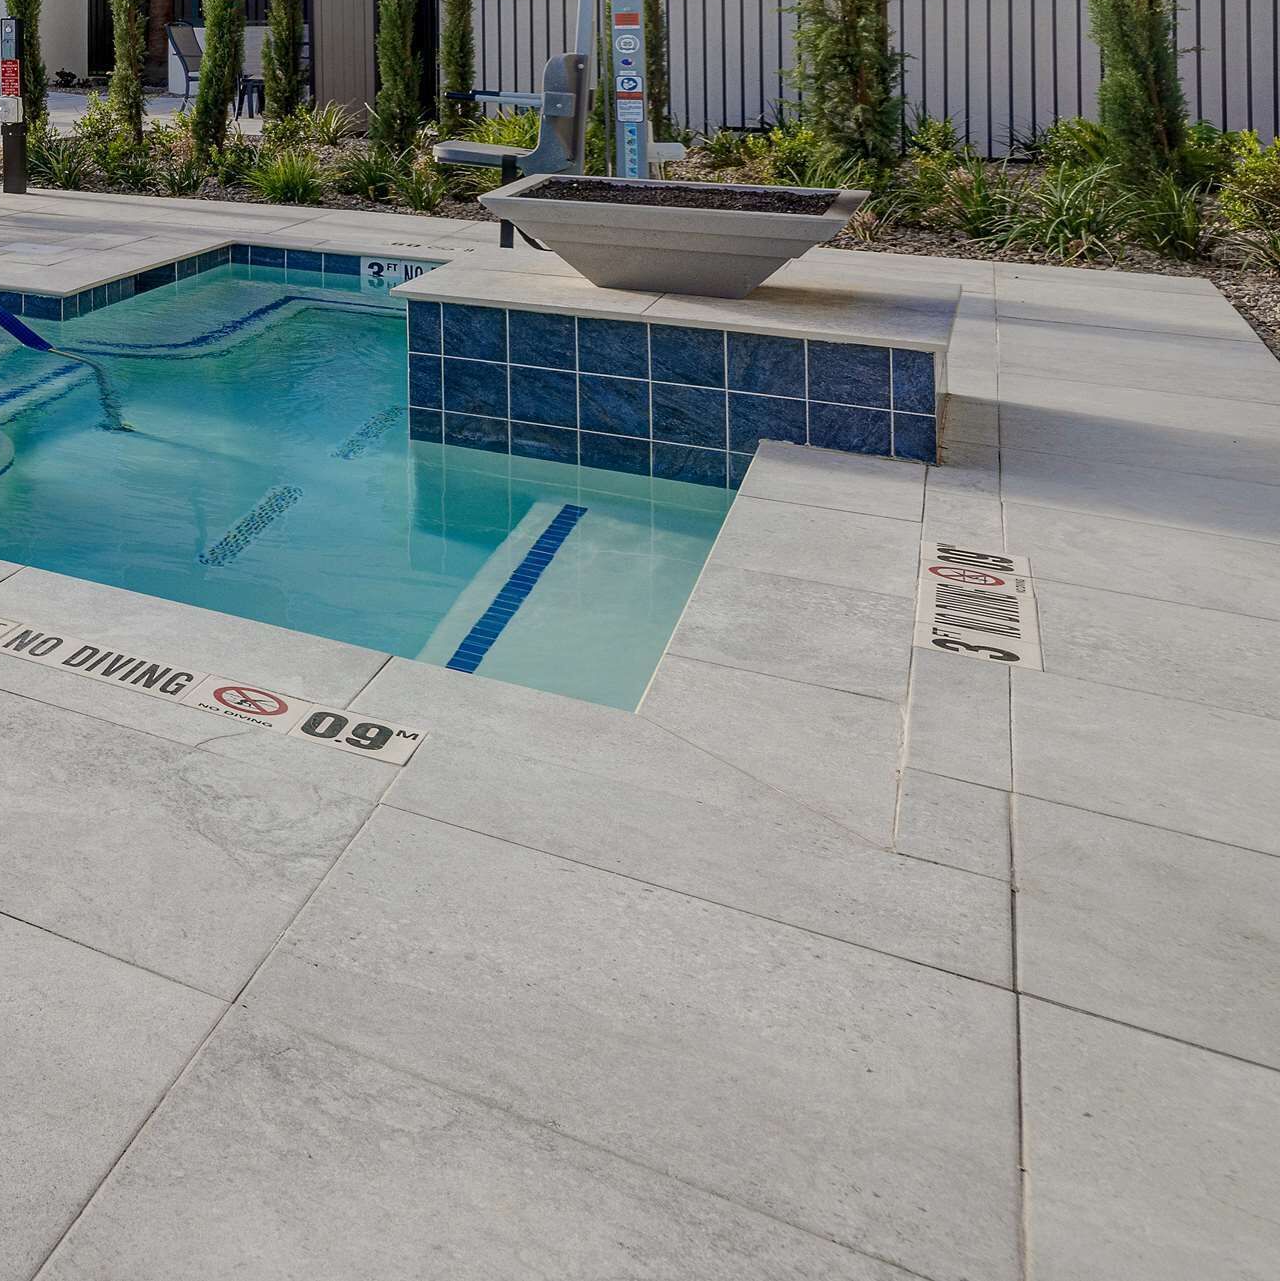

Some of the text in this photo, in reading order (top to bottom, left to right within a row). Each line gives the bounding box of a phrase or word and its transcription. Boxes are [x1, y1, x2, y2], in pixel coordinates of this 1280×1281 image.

[367, 261, 423, 281] 3 FT NO
[935, 583, 1020, 623] DIVING
[932, 627, 961, 640] FT
[934, 612, 1021, 639] NO
[931, 638, 1020, 662] 3
[2, 629, 64, 657] NO
[61, 644, 194, 696] DIVING
[300, 711, 394, 751] 0.9
[395, 729, 419, 741] M
[197, 702, 273, 728] NO DIVING
